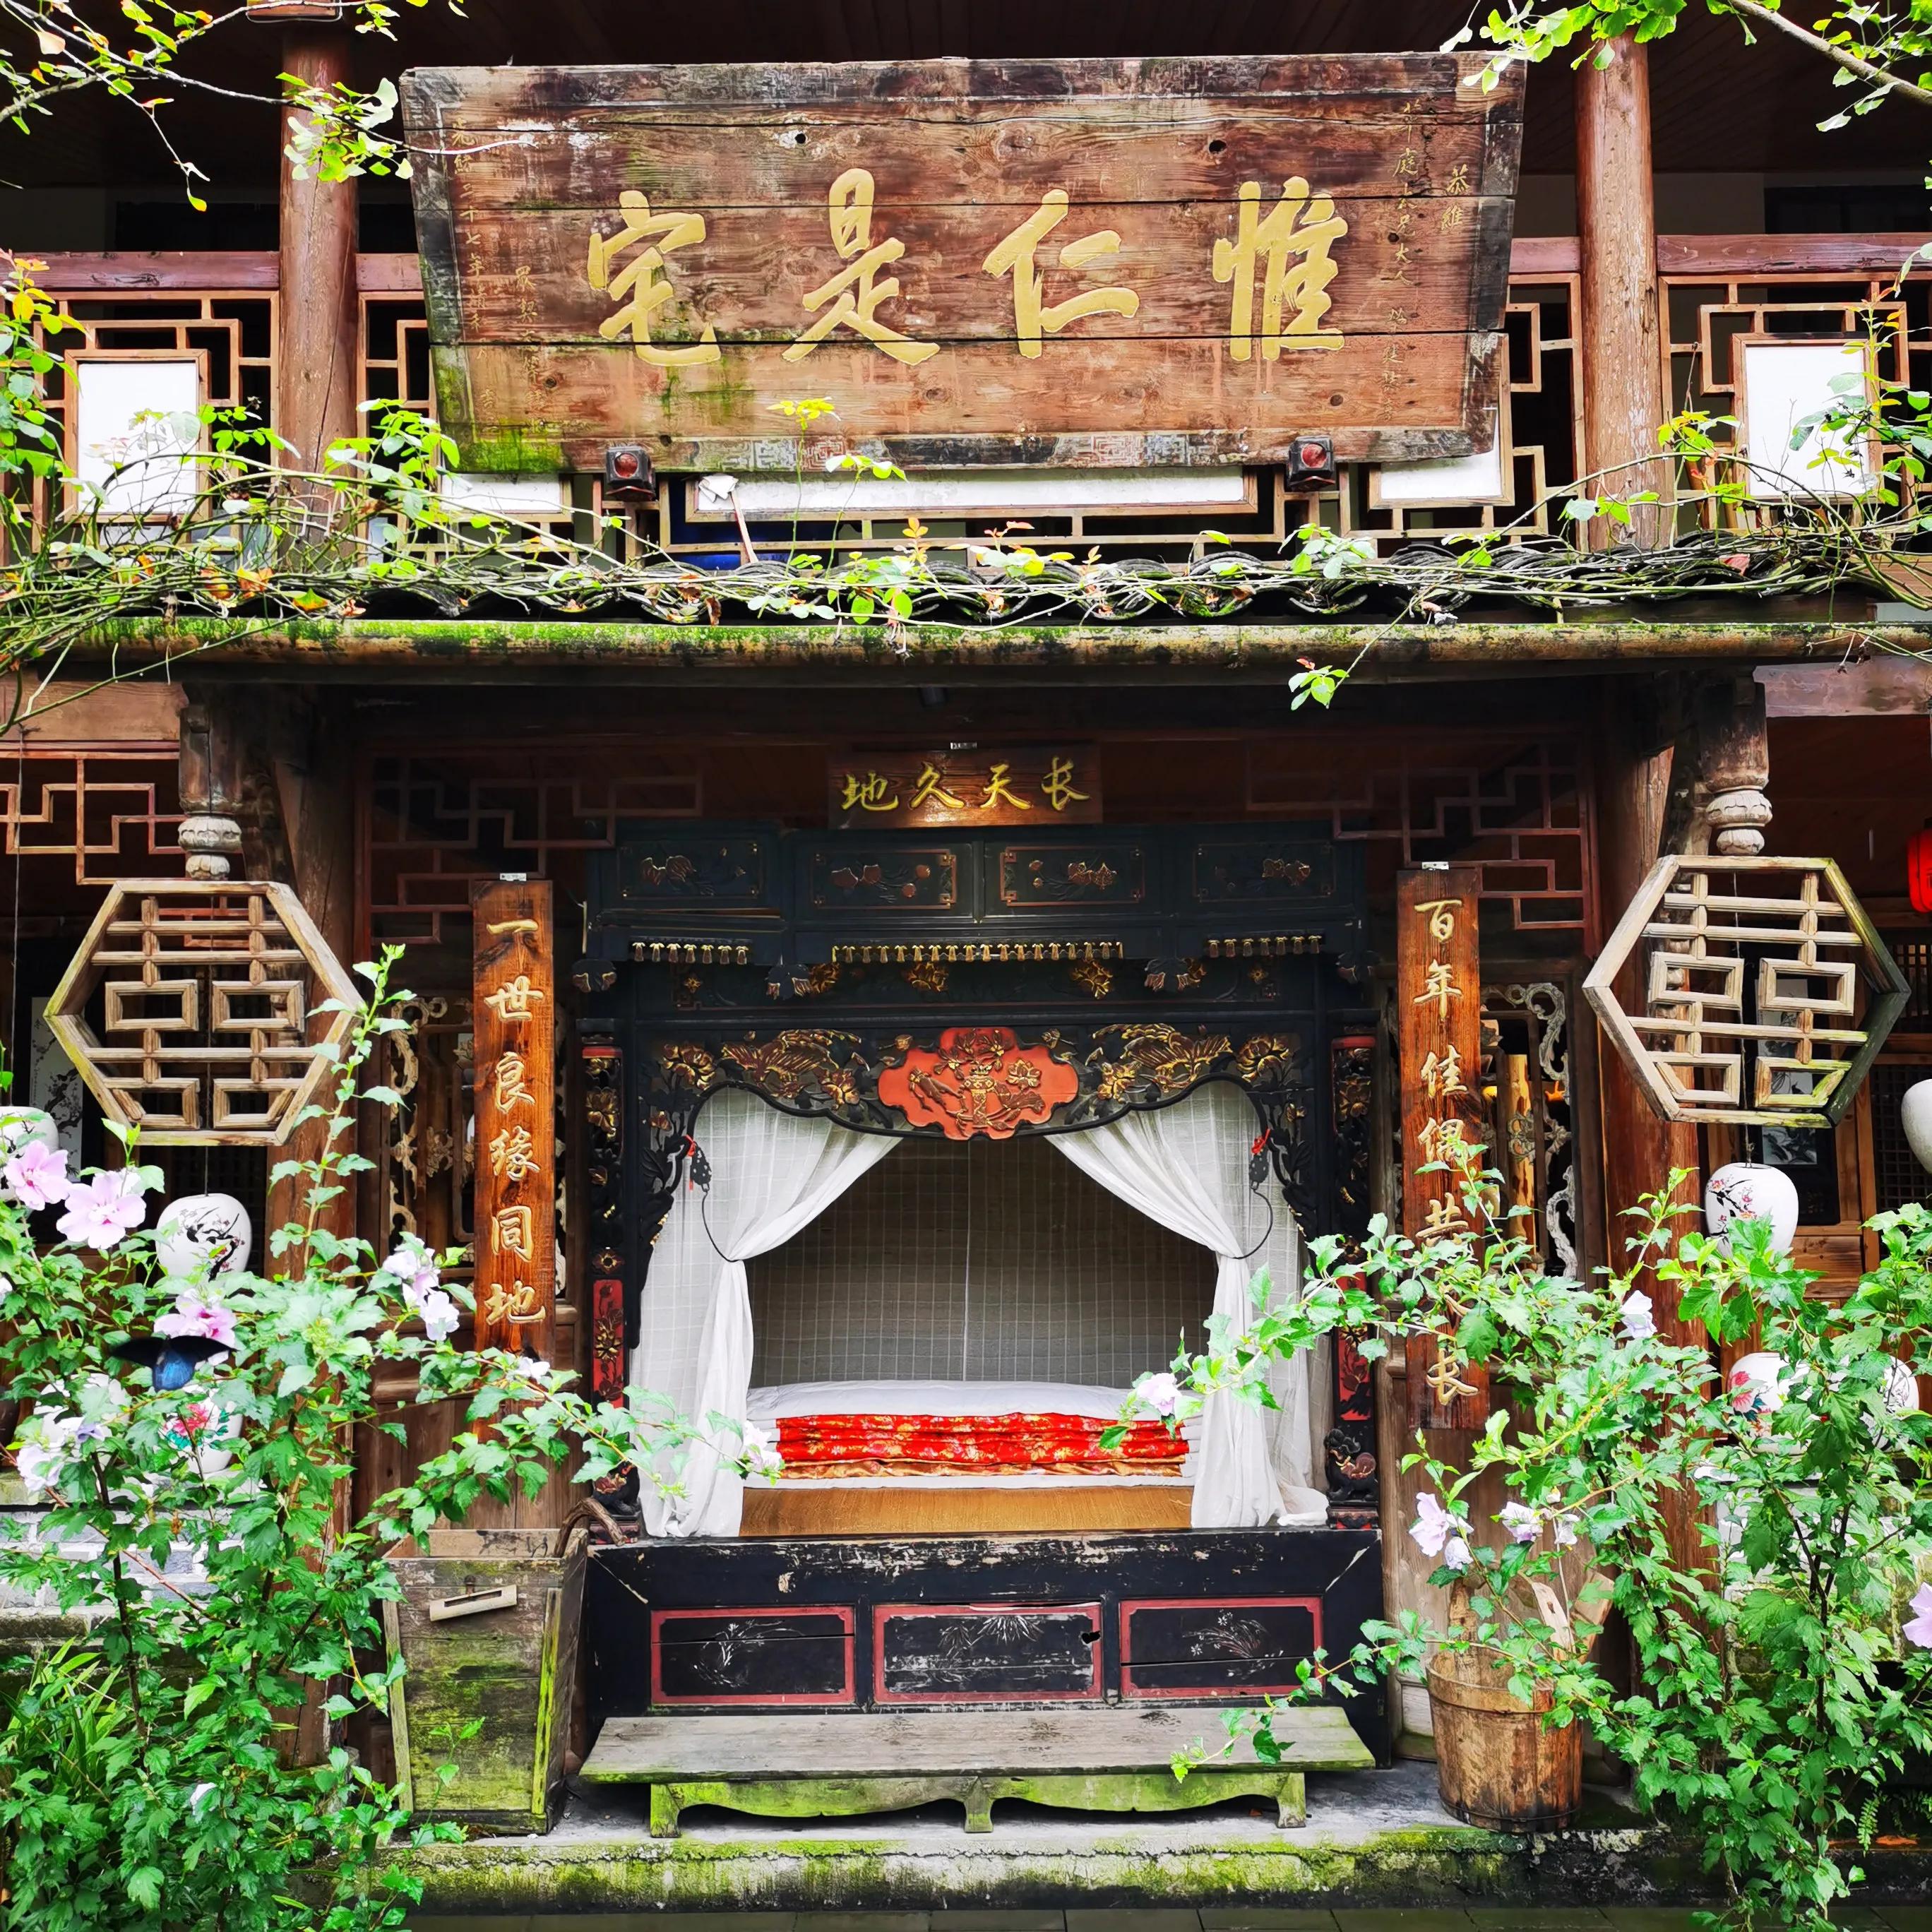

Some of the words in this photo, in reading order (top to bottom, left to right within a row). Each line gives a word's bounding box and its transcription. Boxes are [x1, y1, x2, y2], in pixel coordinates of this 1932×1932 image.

[484, 919, 546, 1401] 一世良缘同地
[1413, 899, 1479, 1406] 百年佳偶共长
